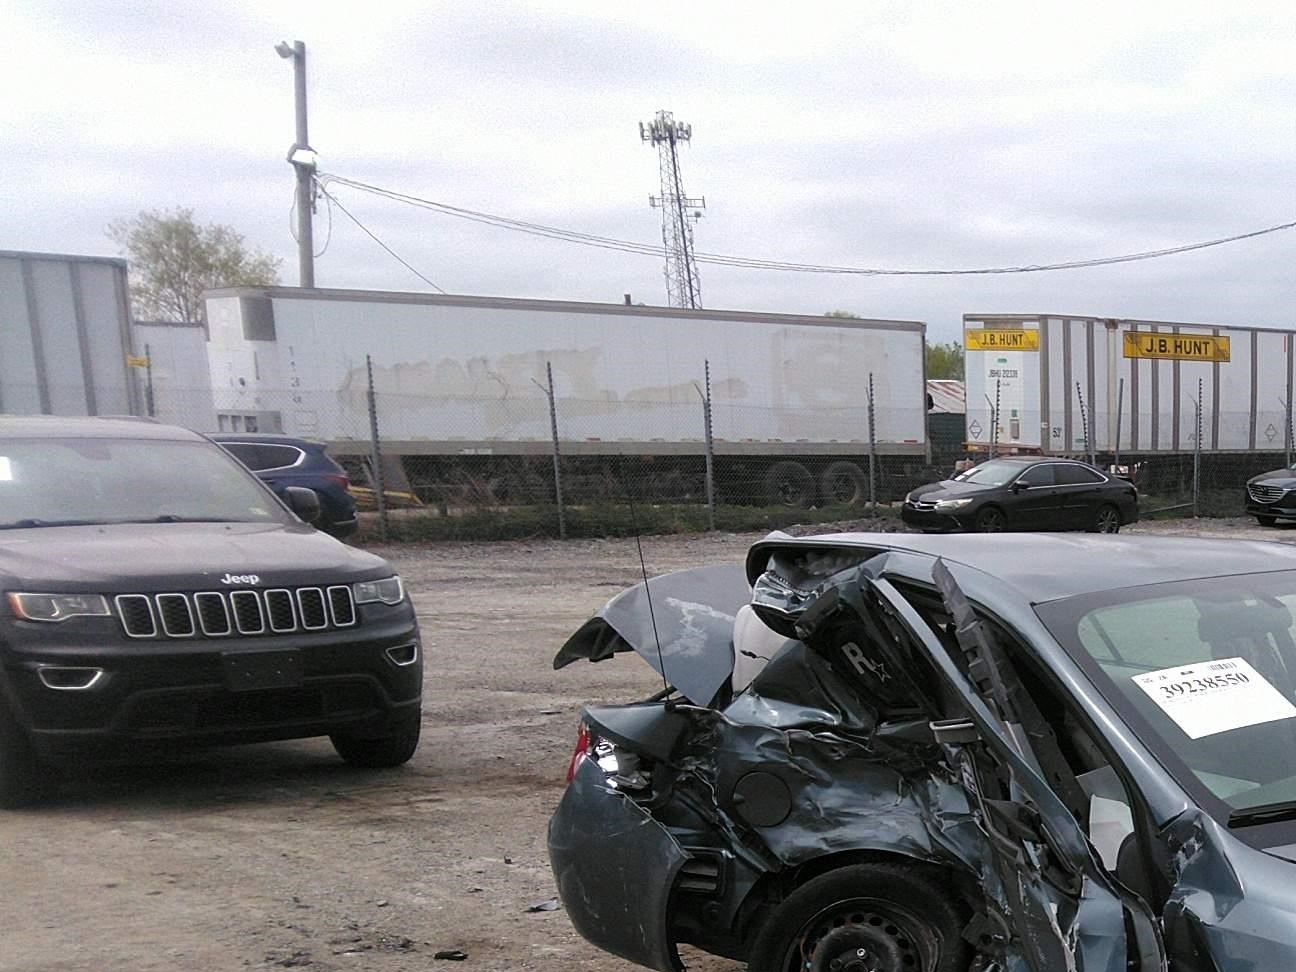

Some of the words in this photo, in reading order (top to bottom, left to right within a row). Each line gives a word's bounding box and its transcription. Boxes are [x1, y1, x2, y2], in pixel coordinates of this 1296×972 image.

[982, 333, 998, 346] J.B.
[999, 333, 1024, 346] HUNT
[1145, 338, 1171, 353] J.B.
[1174, 339, 1210, 355] HUNT
[221, 574, 260, 584] Jeep
[1159, 672, 1250, 699] 39238550
